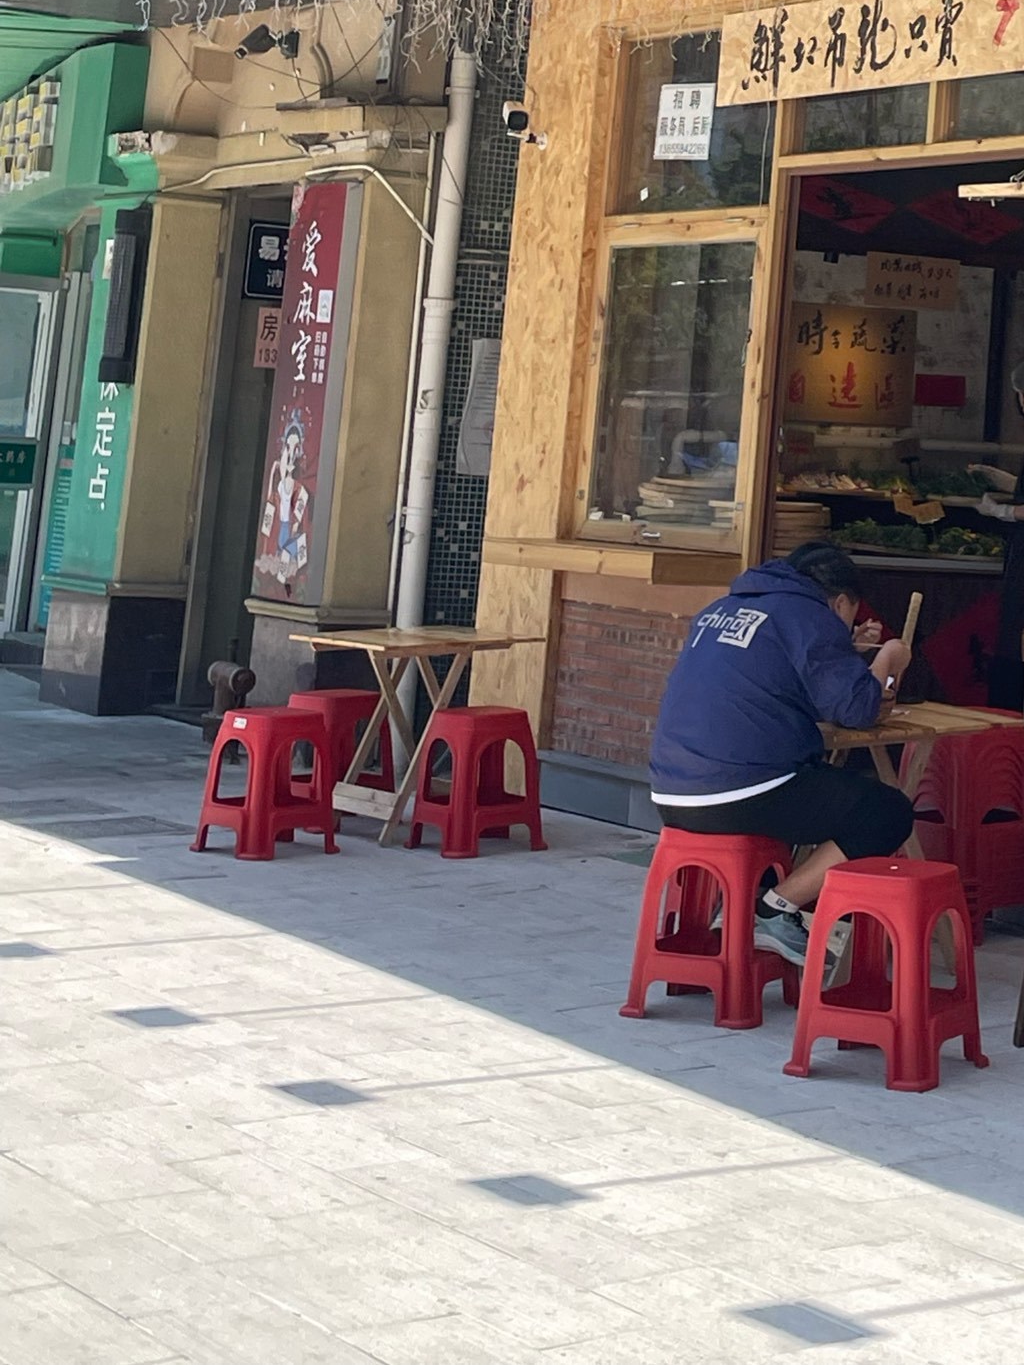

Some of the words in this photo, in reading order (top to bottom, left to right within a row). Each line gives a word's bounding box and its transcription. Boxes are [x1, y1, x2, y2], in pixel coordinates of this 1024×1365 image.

[258, 235, 289, 262] 易
[291, 221, 321, 381] 爱麻室
[260, 312, 278, 341] 房
